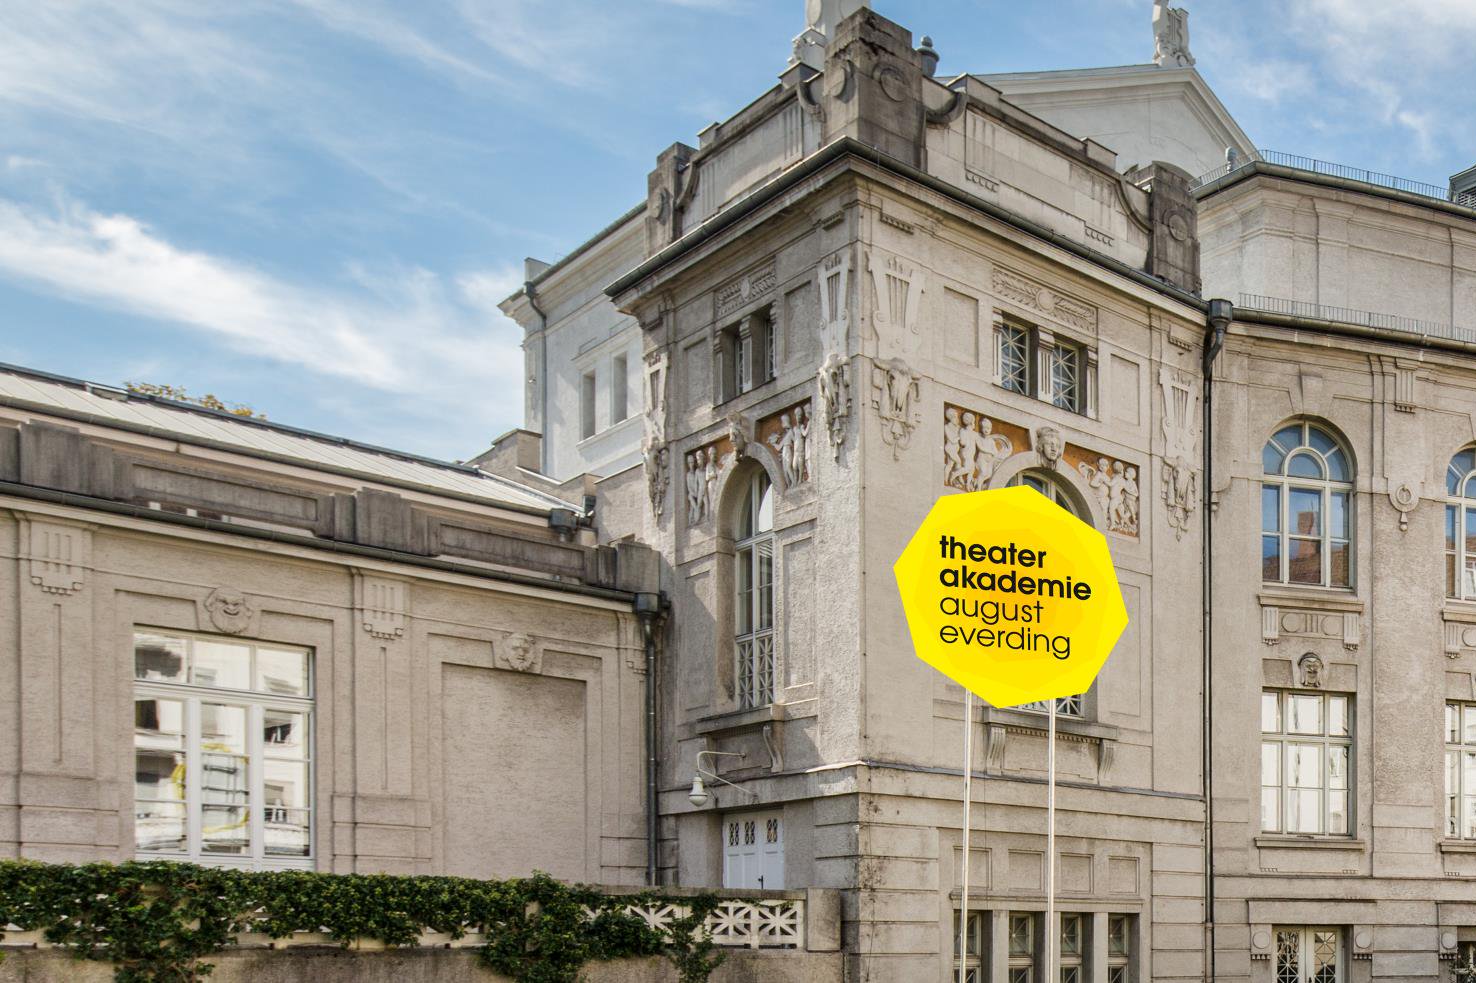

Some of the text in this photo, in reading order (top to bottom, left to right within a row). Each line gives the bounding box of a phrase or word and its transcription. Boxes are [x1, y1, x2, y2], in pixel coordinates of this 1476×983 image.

[939, 535, 1047, 569] theater
[939, 565, 1092, 601] akademie
[939, 596, 1044, 626] august
[939, 625, 1071, 660] everding
